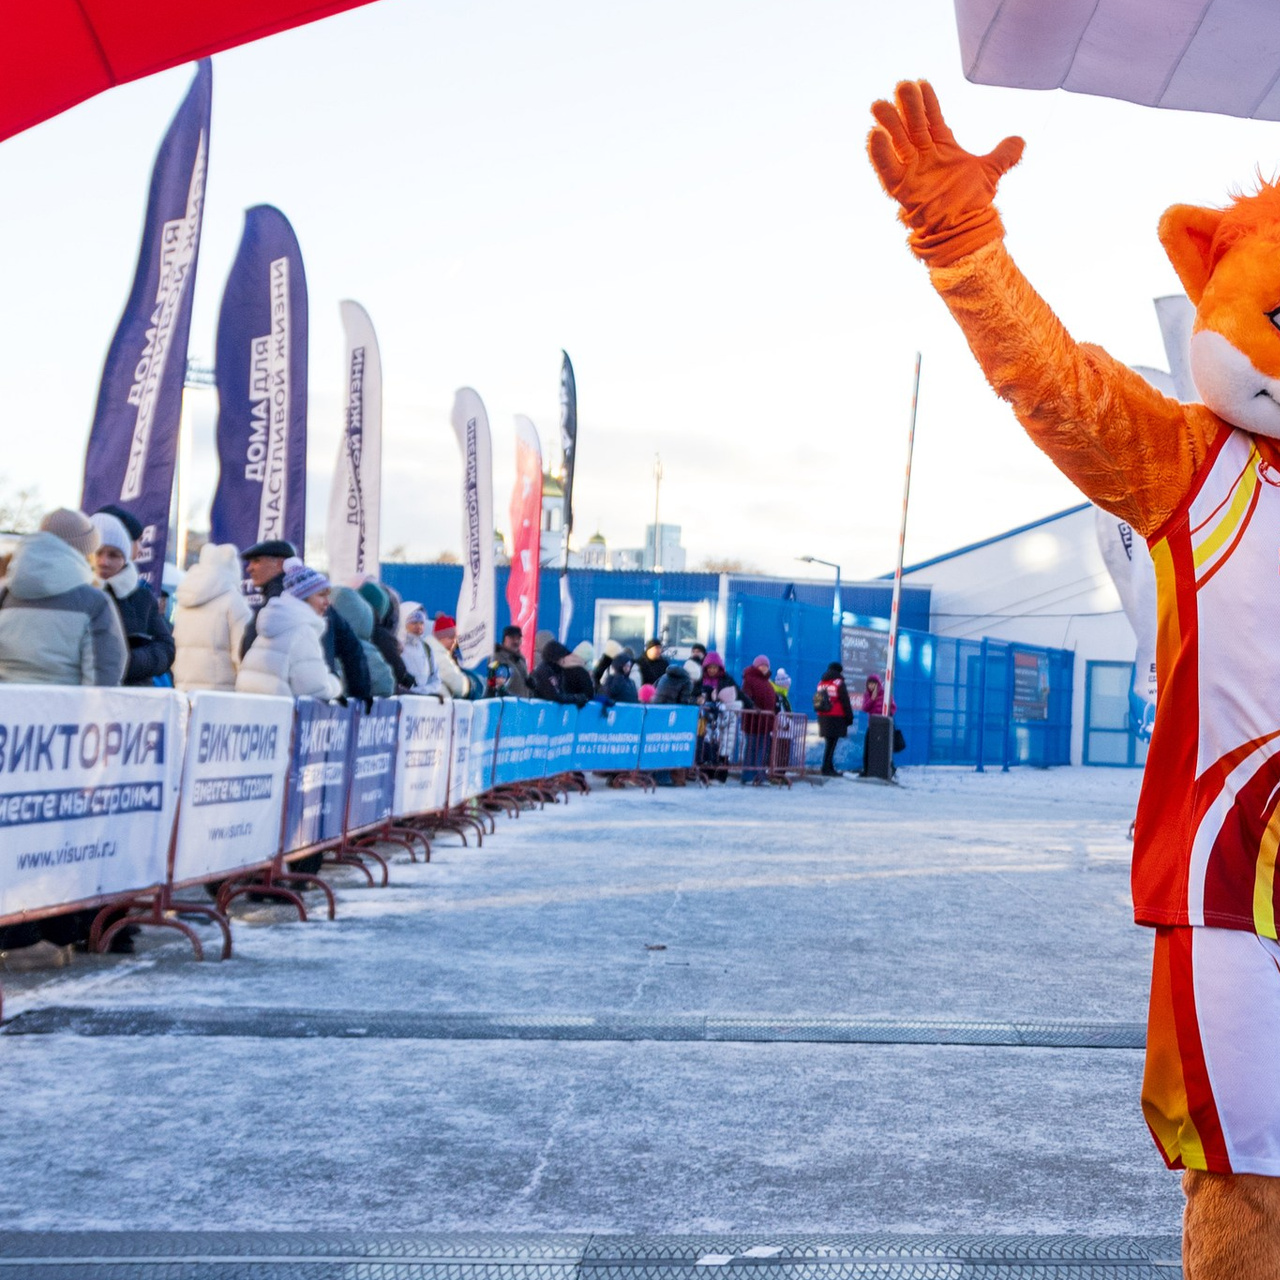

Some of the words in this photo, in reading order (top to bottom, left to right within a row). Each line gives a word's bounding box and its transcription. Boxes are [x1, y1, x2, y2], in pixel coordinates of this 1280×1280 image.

[272, 260, 286, 360] ЖИЗНИ
[254, 339, 271, 394] ДЛЯ
[244, 399, 270, 482] ДОМА
[198, 722, 278, 764] ВИКТОРИЯ
